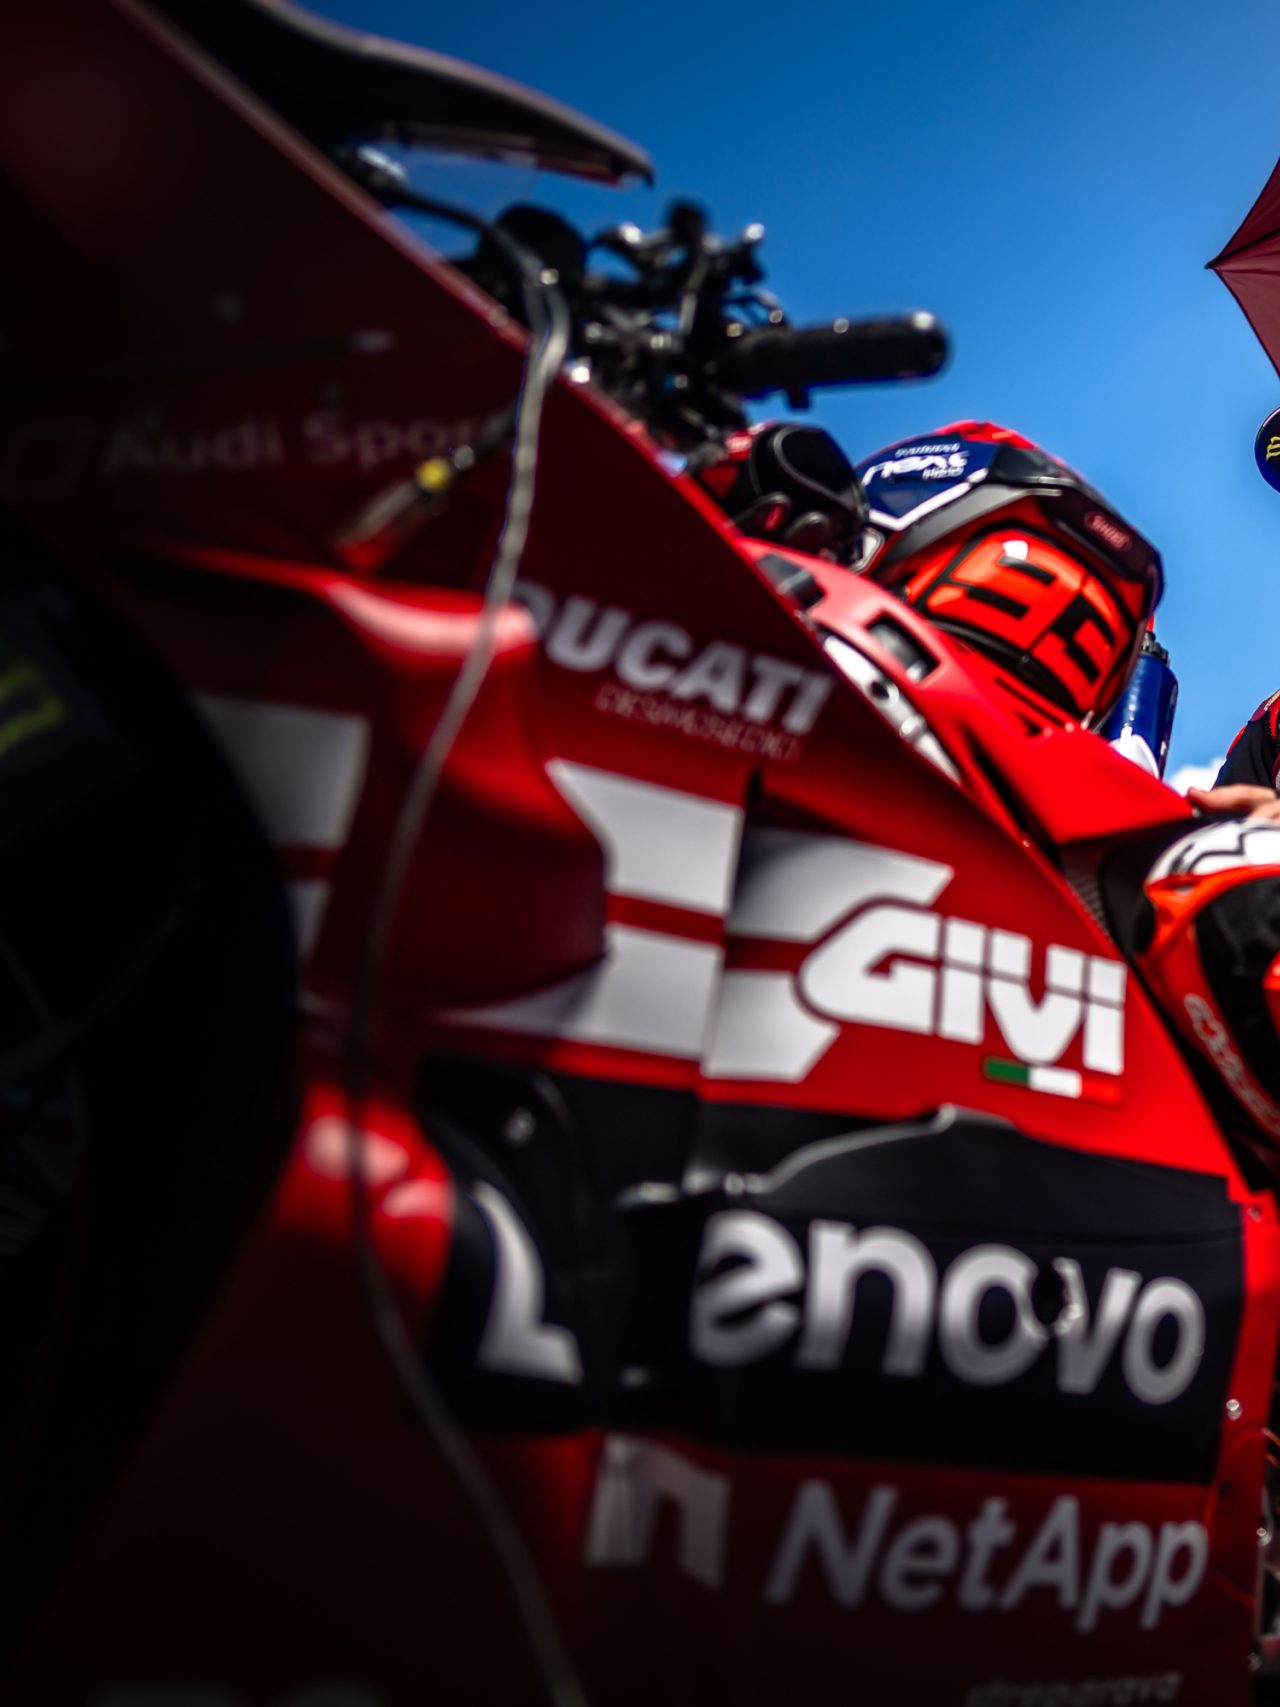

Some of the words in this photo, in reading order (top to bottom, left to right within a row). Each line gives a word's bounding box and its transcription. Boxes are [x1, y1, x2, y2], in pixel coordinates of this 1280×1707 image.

[302, 406, 485, 472] Spor
[514, 581, 832, 734] DUCATI
[800, 904, 1127, 1076] GIVI
[474, 1180, 1206, 1404] Lenovo
[766, 1474, 1208, 1631] NetApp
